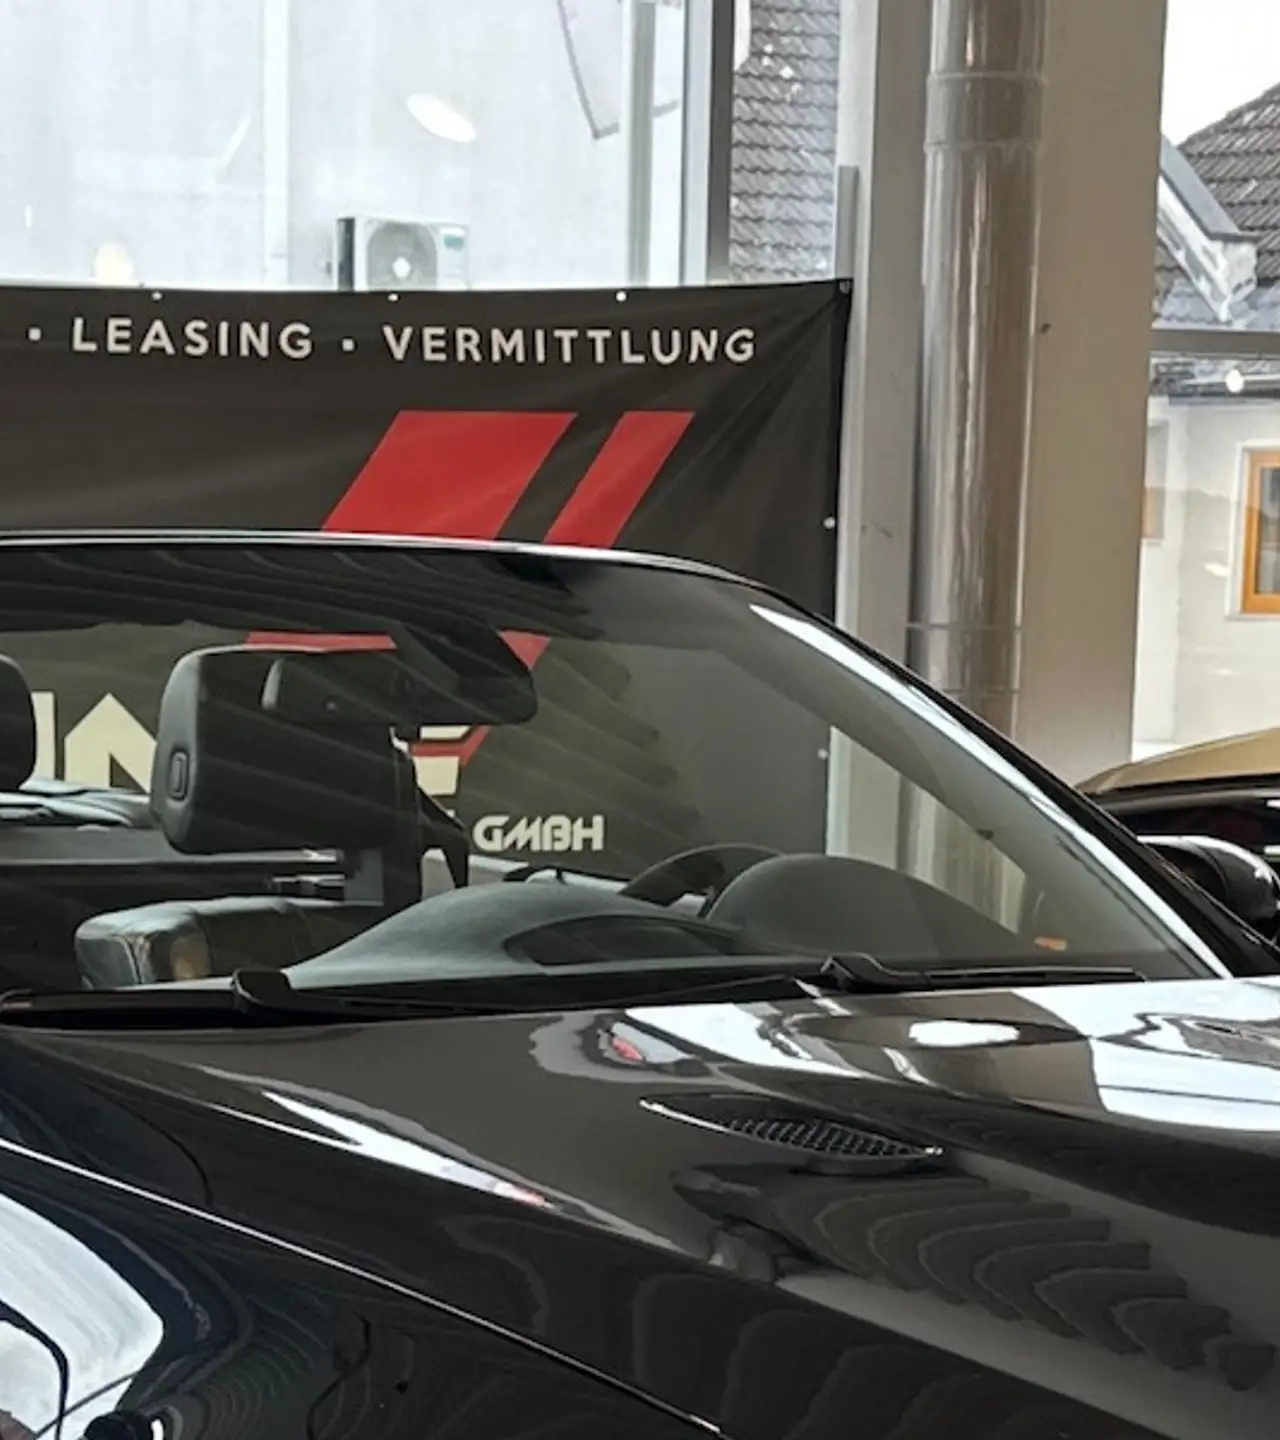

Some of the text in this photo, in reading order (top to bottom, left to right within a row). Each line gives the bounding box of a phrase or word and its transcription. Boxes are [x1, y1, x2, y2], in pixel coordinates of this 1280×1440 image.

[72, 317, 313, 359] LEASING
[381, 324, 756, 364] VERMITTLUNG
[472, 814, 605, 852] GMBH
